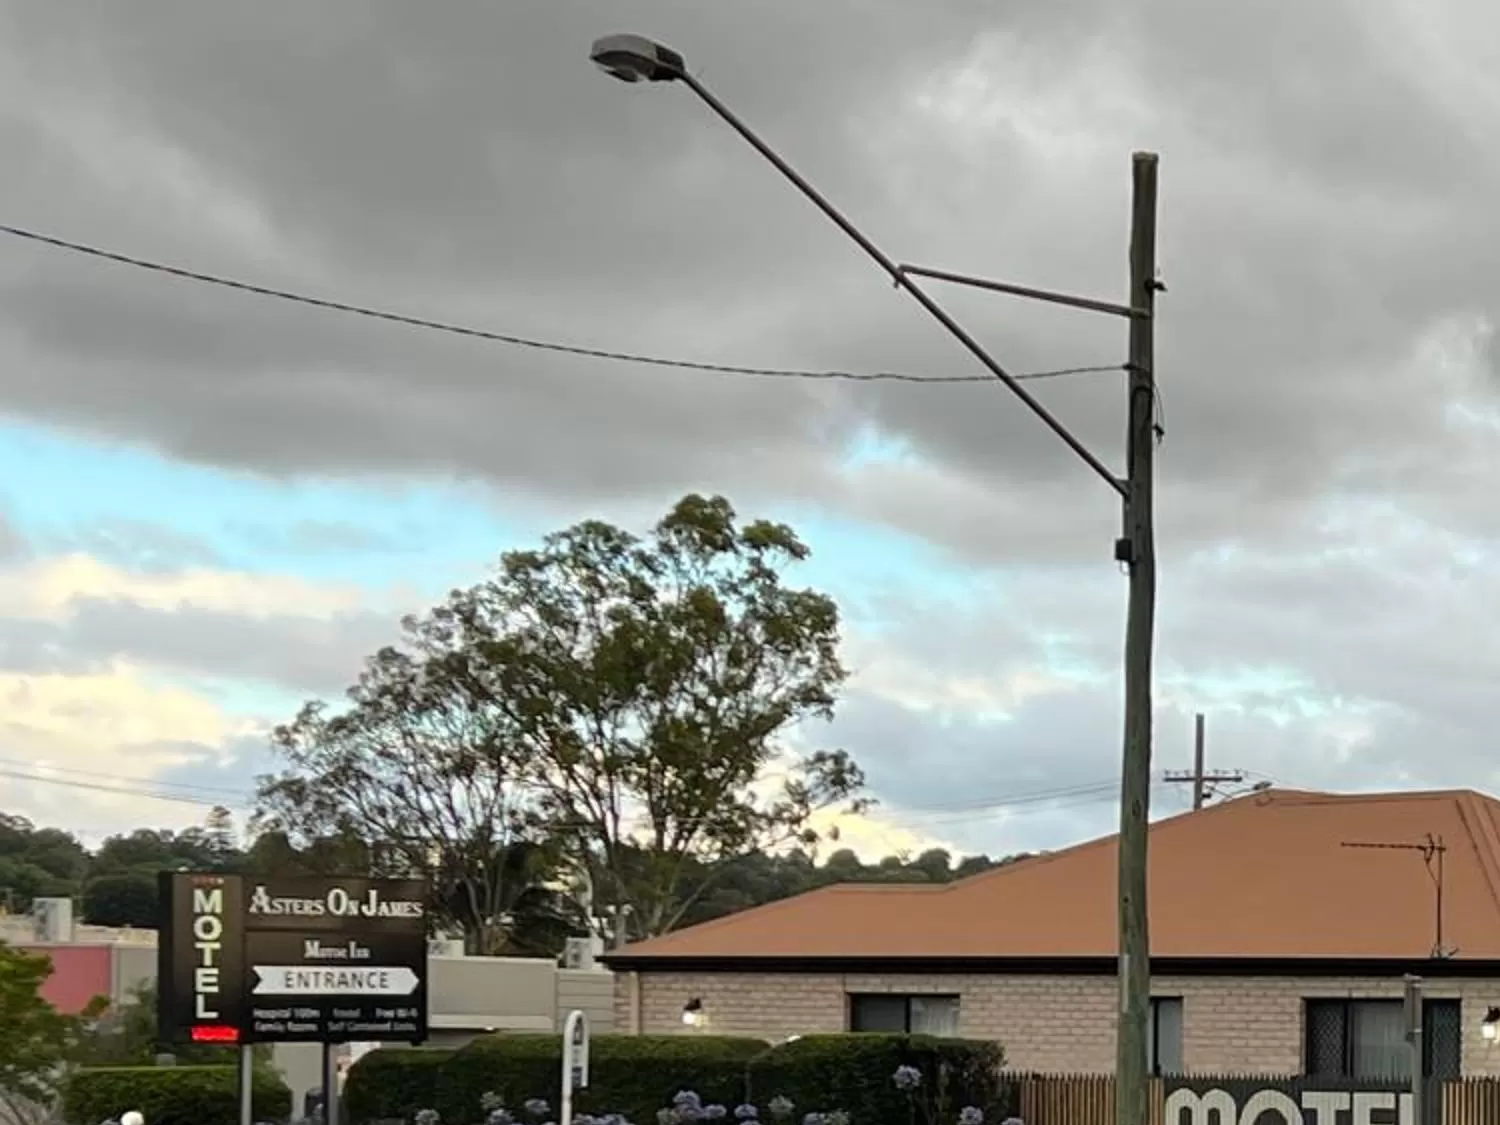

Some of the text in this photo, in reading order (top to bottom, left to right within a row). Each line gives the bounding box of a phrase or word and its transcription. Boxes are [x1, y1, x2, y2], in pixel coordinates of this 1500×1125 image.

[249, 885, 326, 915] ASTERS
[327, 891, 360, 916] ON
[193, 888, 223, 1018] MOTEL
[284, 970, 390, 989] ENTRANCE
